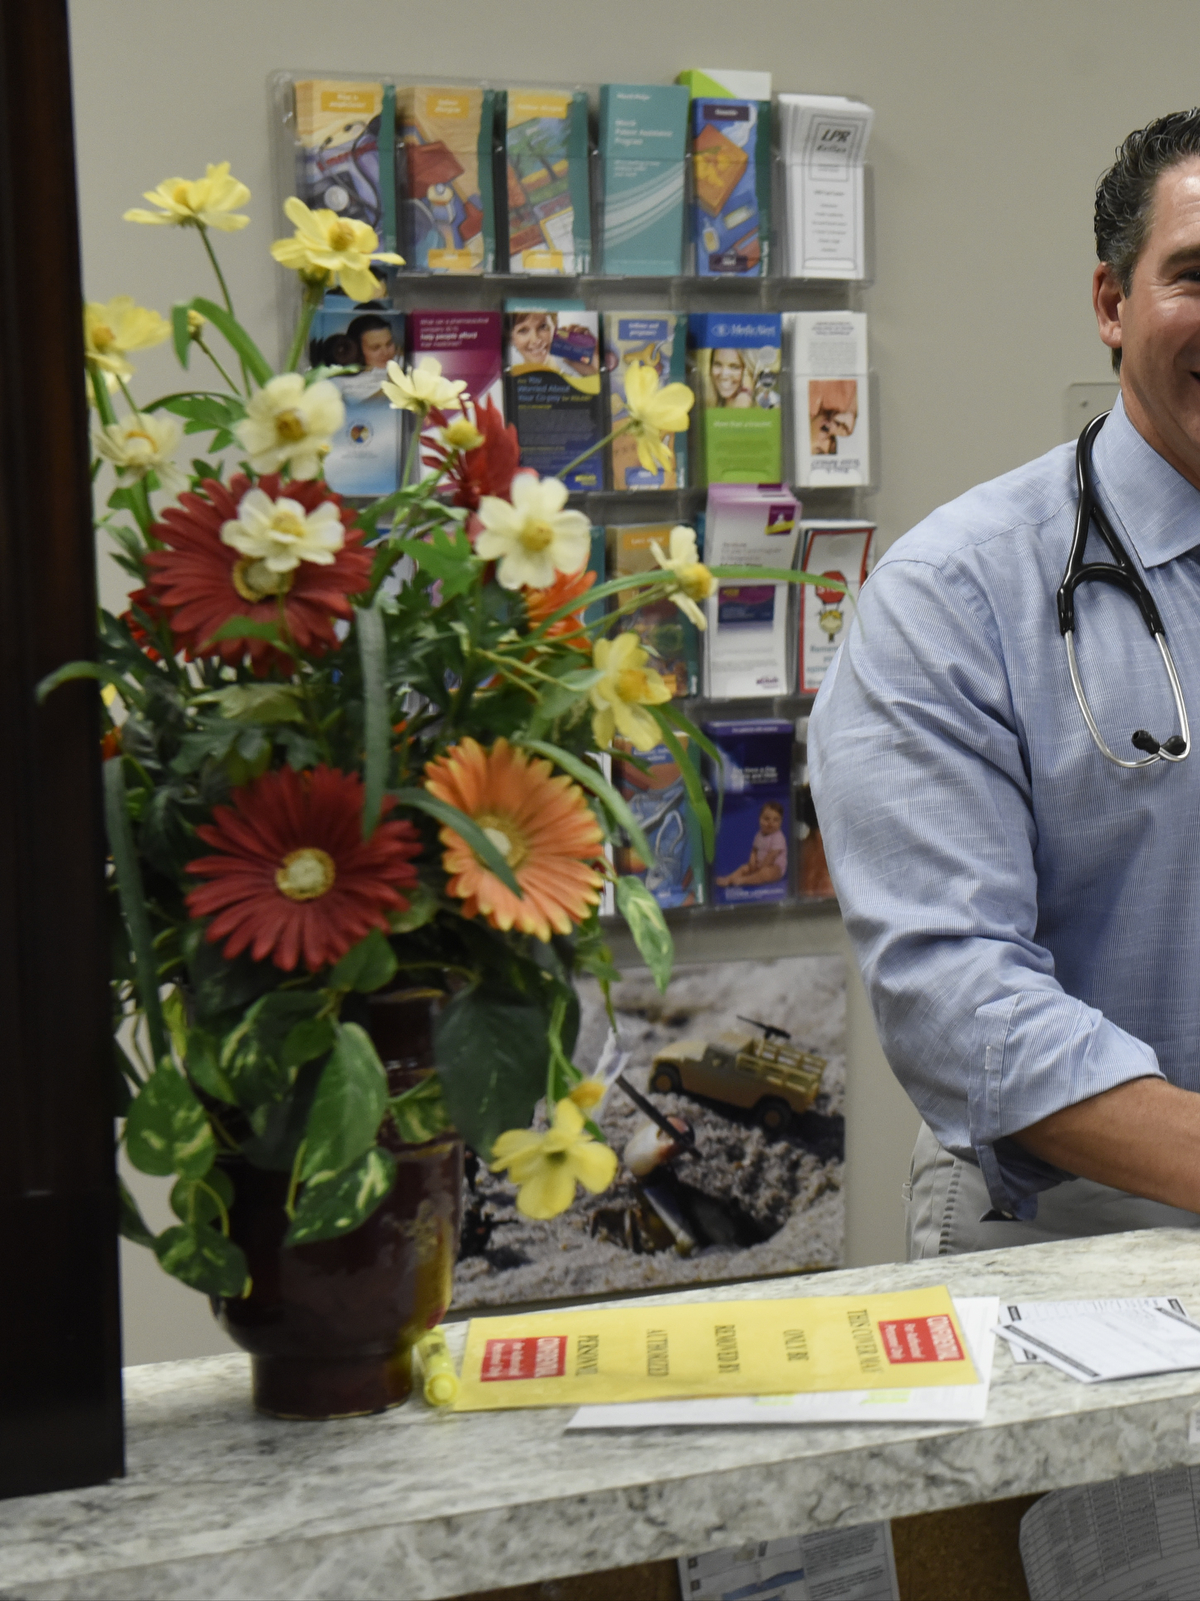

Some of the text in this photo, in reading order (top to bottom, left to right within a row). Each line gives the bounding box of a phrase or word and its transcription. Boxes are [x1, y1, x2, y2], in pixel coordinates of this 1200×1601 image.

[821, 128, 852, 143] LPR
[420, 331, 478, 342] help people afford
[518, 384, 571, 393] Worried About
[528, 376, 543, 384] You
[518, 394, 535, 402] Your
[646, 1328, 669, 1377] AUTHORIZED
[714, 1324, 740, 1374] REMOVED BY
[783, 1329, 809, 1362] ONLY BE
[847, 1309, 884, 1373] THIS COVER MAY
[926, 1316, 961, 1361] CONFIDENTIAL
[534, 1337, 560, 1379] CONFIDENTIAL
